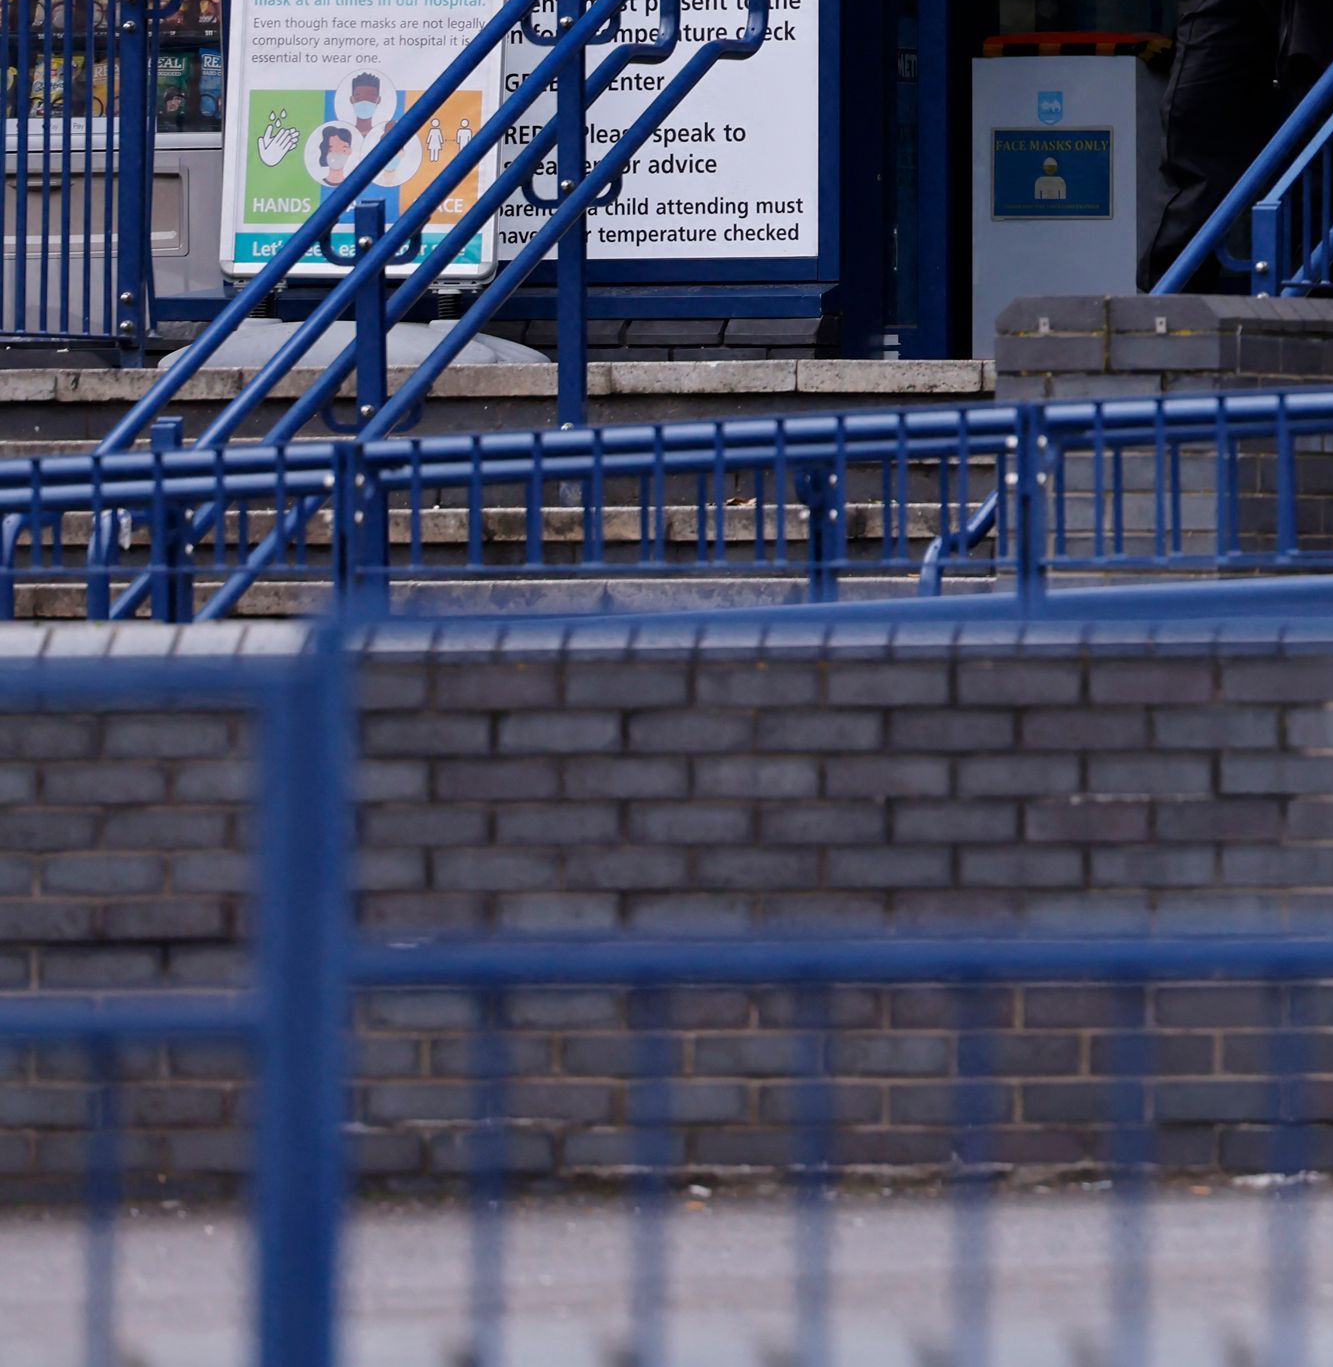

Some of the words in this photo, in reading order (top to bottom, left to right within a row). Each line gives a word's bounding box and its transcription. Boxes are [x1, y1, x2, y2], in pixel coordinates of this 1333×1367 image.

[253, 17, 281, 29] Even
[285, 17, 328, 32] though
[332, 17, 357, 29] face
[360, 17, 396, 29] masks
[400, 19, 419, 29] are
[422, 18, 443, 29] not
[447, 17, 486, 32] legally
[252, 35, 320, 50] compulsory
[323, 37, 379, 49] anymore,
[383, 36, 395, 46] at
[399, 35, 446, 49] hospital
[450, 35, 458, 46] it
[461, 35, 470, 46] is
[251, 52, 302, 64] essential
[306, 53, 318, 64] to
[321, 54, 351, 64] wear
[355, 54, 381, 64] one.
[608, 72, 665, 92] Enter
[653, 122, 715, 148] speak
[724, 123, 746, 143] to
[995, 139, 1026, 152] FACE
[1030, 139, 1072, 152] MASKS
[1075, 139, 1109, 152] ONLY
[648, 153, 717, 175] advice
[252, 198, 312, 214] HANDS
[605, 198, 649, 216] child
[656, 197, 749, 219] attending
[757, 198, 804, 214] must
[598, 226, 717, 247] temperature
[723, 223, 799, 242] checked
